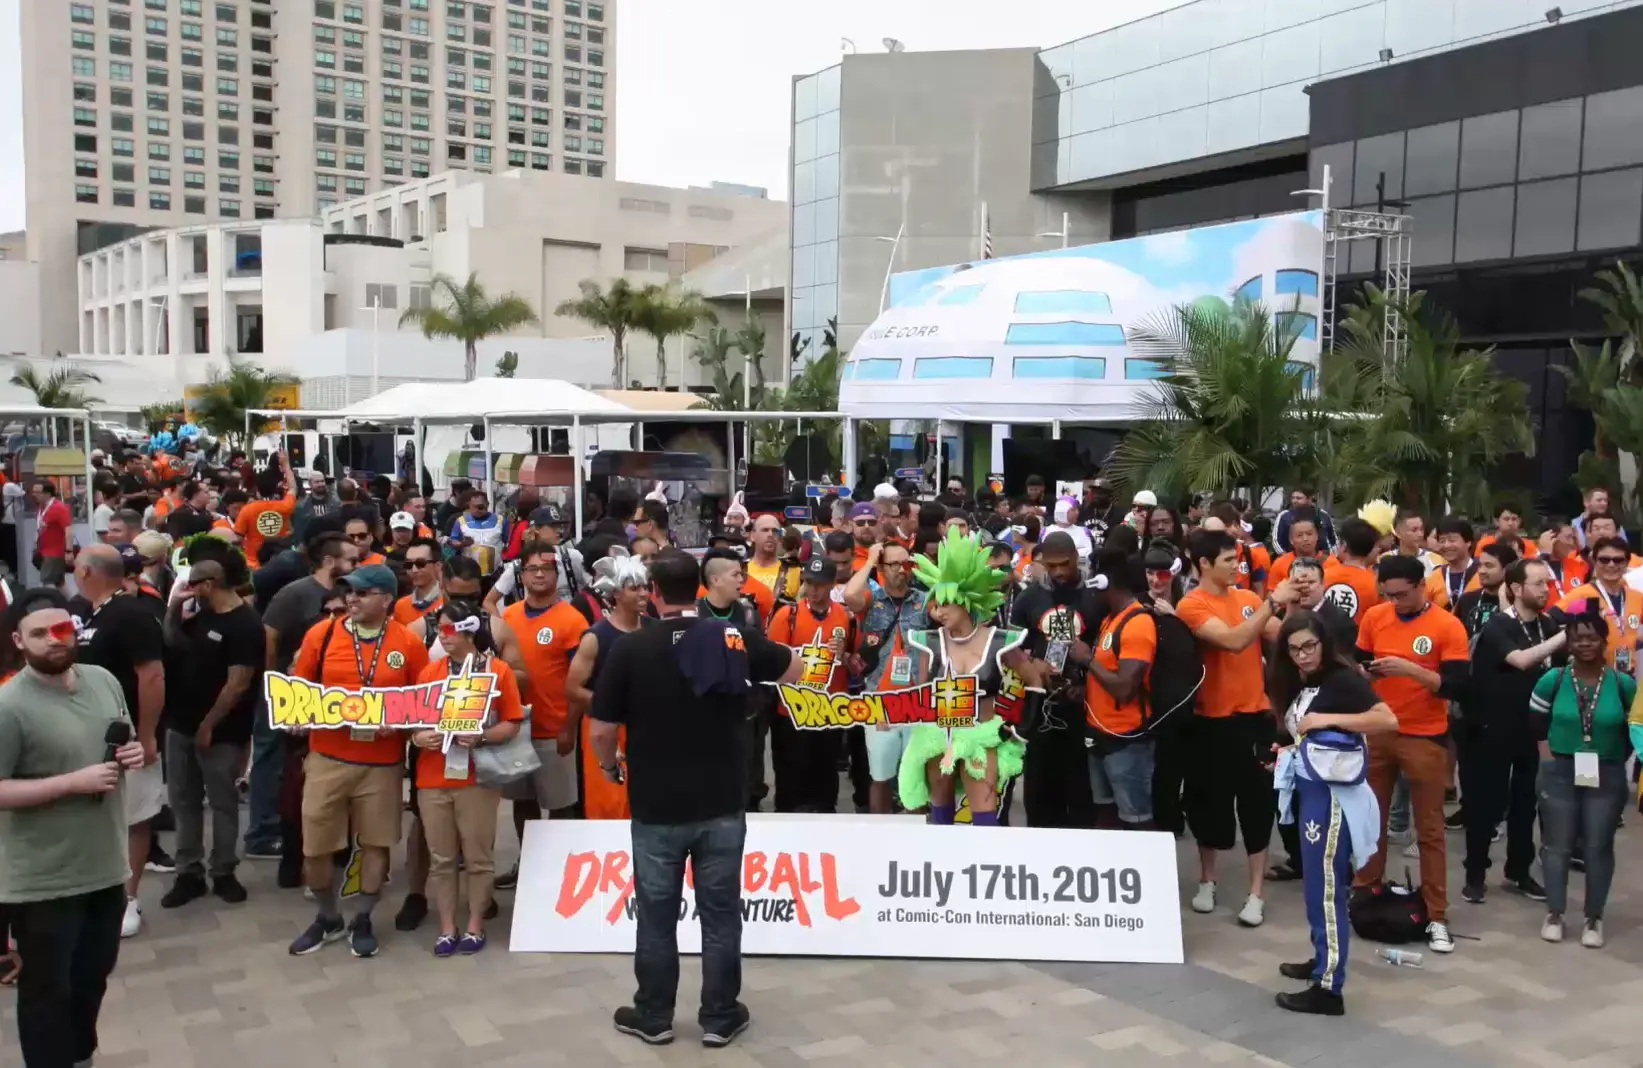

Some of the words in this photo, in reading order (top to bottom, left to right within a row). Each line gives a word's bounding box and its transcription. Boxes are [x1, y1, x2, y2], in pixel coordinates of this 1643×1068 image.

[439, 720, 479, 731] SUPER
[938, 717, 974, 727] SUPER
[878, 861, 954, 907] July
[877, 909, 892, 923] at
[895, 908, 972, 925] Comic-Con
[976, 910, 1070, 927] International:
[1074, 912, 1101, 927] San
[1104, 913, 1144, 931] Diego
